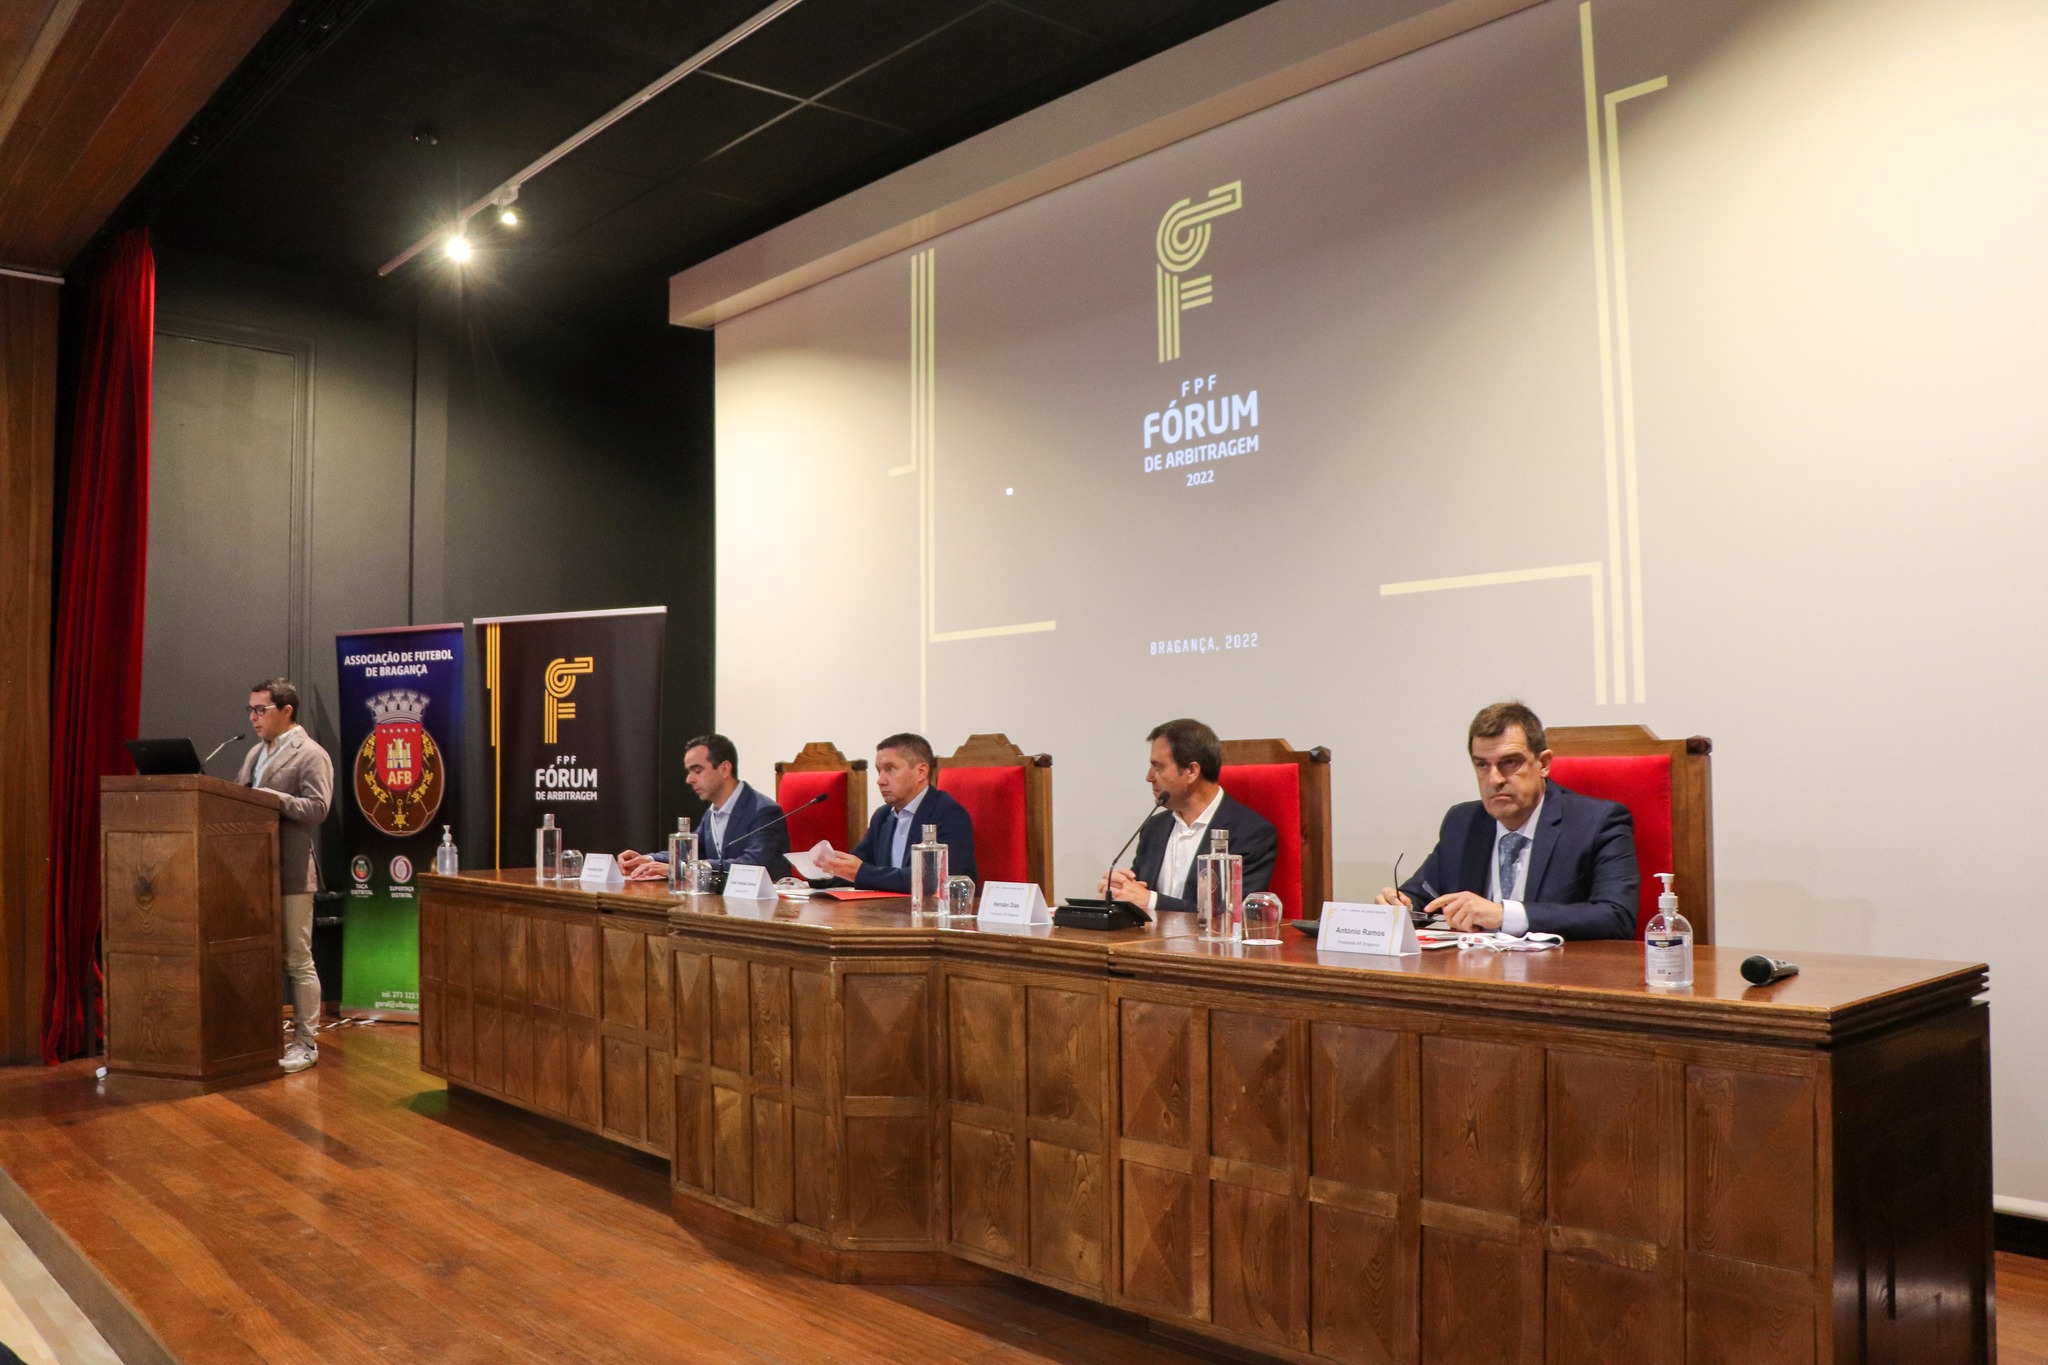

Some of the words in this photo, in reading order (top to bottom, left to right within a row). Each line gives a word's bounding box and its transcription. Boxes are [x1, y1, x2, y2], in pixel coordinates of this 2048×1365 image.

[1143, 390, 1259, 449] FÓRUM
[1144, 454, 1163, 473] DE
[1165, 434, 1259, 469] ARBITRAGEM
[1186, 469, 1215, 487] 2022
[1150, 636, 1220, 656] BRAGANÇA,
[1225, 632, 1258, 649] 2022
[344, 651, 400, 666] ASSOCIAÇÃO
[401, 652, 413, 662] DE
[414, 649, 454, 661] FUTEBOL
[365, 667, 378, 677] DE
[379, 664, 428, 677] BRAGANÇA
[387, 770, 412, 785] AFB
[535, 764, 598, 788] FÓRUM
[535, 791, 546, 800] DE
[547, 791, 598, 800] ARBITRAGEM
[1335, 926, 1361, 935] António
[1362, 928, 1385, 937] Ramos
